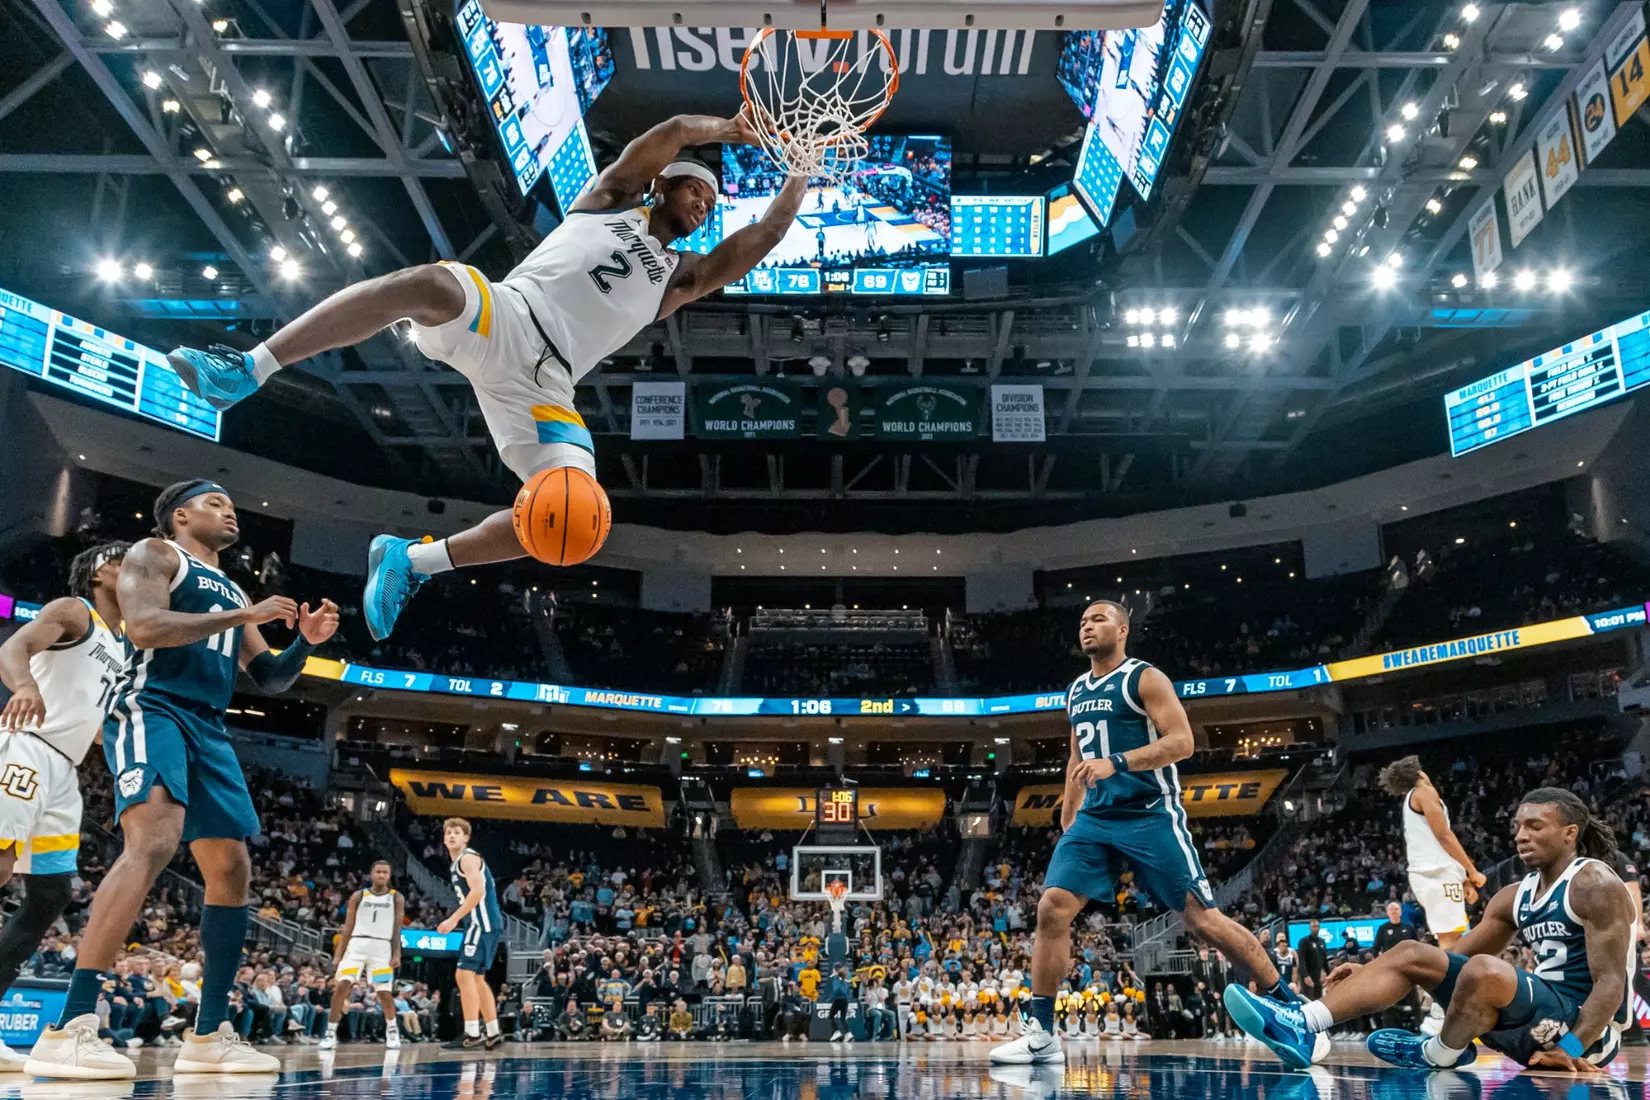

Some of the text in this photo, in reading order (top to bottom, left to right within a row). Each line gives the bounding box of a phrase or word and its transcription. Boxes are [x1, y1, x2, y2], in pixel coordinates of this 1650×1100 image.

[1620, 52, 1644, 97] 14
[1511, 176, 1536, 217] HANK
[604, 219, 666, 285] Marquette
[588, 250, 633, 294] 2
[864, 275, 887, 288] 69
[1459, 373, 1508, 400] MARQUETTE
[636, 395, 683, 404] CONFERENCE
[996, 403, 1039, 413] CHAMPIONS
[1001, 393, 1033, 403] DIVISION
[637, 405, 680, 415] CHAMPIONS
[705, 420, 795, 431] WORLD CHAMPIONS
[882, 422, 972, 432] WORLD CHAMPIONS
[1594, 610, 1646, 629] 10:01 PM
[1383, 630, 1520, 669] #WEAREMARQUETTE
[361, 670, 385, 685] FLS
[404, 675, 416, 688] 7
[449, 678, 472, 692] TOL
[490, 682, 503, 696] 2
[584, 691, 662, 708] MARQUETTE
[1183, 669, 1321, 696] FLS 7 TOL 1
[791, 699, 832, 714] 1:06
[860, 699, 894, 714] 2nd
[1071, 698, 1114, 717] BUTLER
[1076, 719, 1110, 761] 21
[0, 764, 39, 801] MU
[408, 781, 652, 813] WE ARE
[823, 802, 850, 822] 30
[1442, 883, 1463, 903] MU
[1522, 920, 1573, 942] BUTLER
